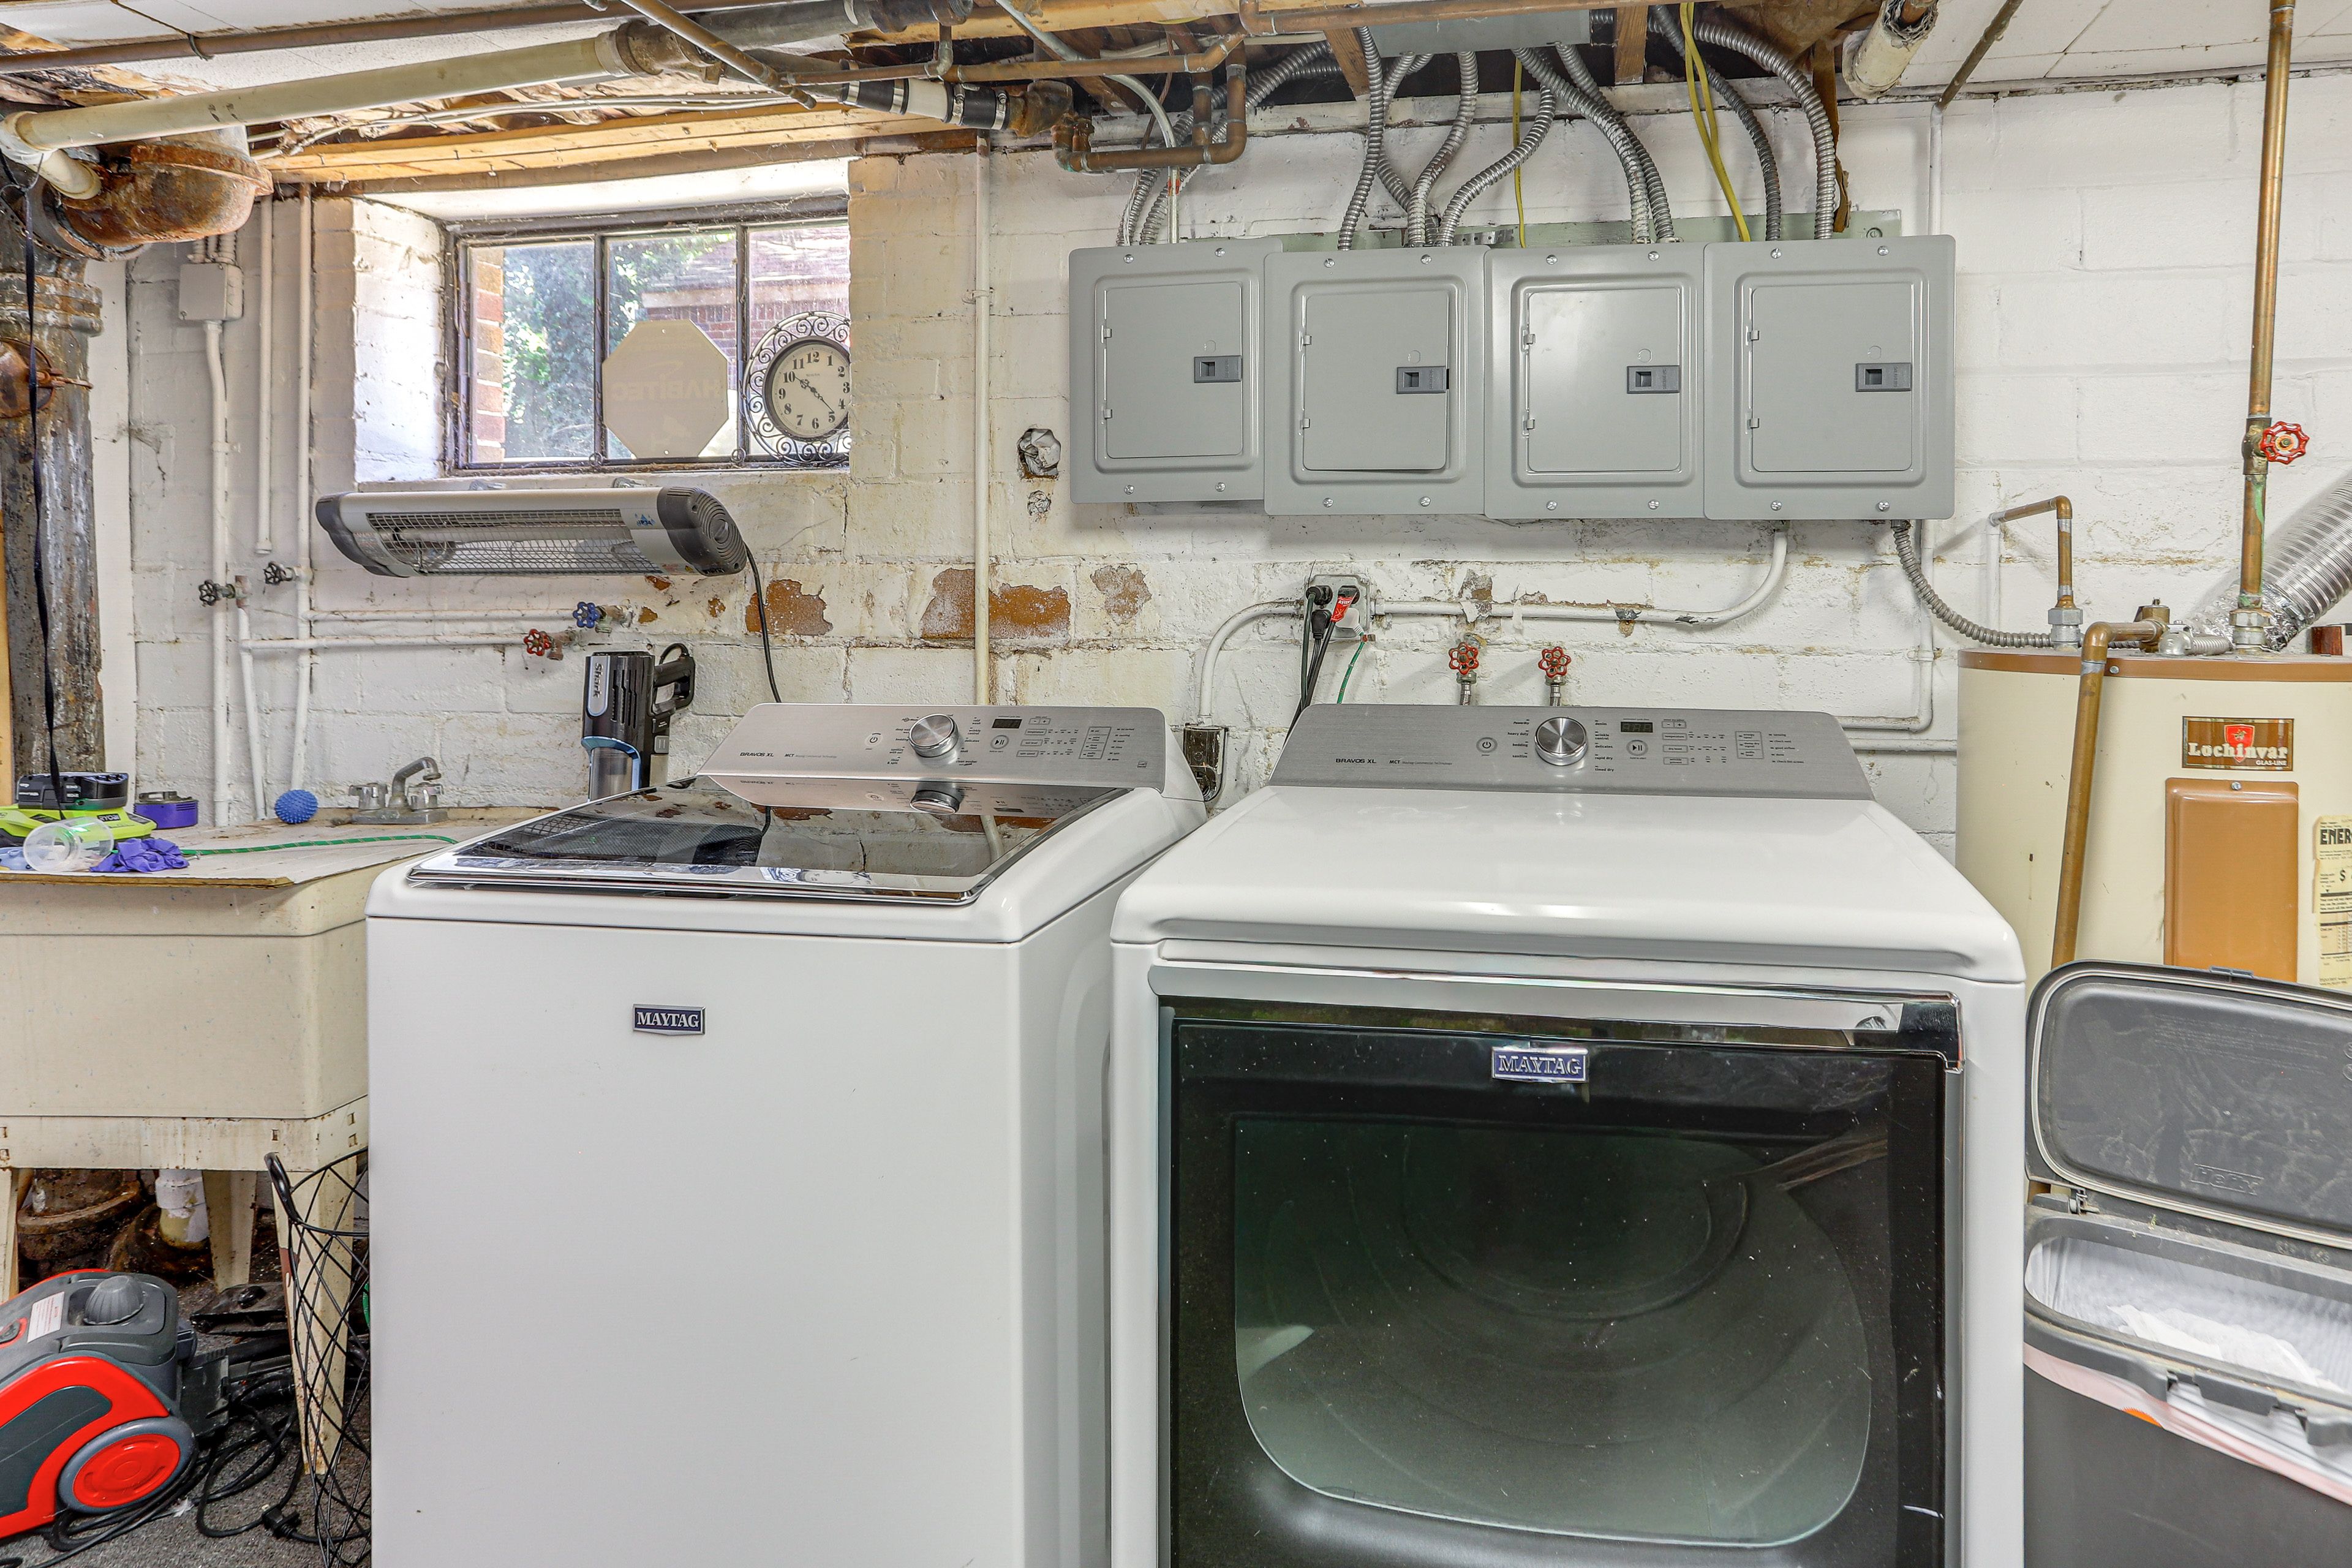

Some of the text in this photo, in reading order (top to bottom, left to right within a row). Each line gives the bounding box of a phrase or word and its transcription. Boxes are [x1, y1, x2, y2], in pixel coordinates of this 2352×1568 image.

[807, 351, 820, 363] 12
[827, 355, 833, 366] 1
[793, 358, 805, 370] 11
[783, 371, 795, 383] 10
[837, 366, 845, 378] 2
[778, 388, 786, 399] 9
[843, 382, 850, 393] 3
[784, 402, 792, 415] 8
[838, 398, 846, 410] 4
[797, 414, 804, 426] 7
[828, 410, 835, 423] 5
[812, 417, 819, 429] 6
[593, 663, 603, 698] Shark
[2188, 742, 2288, 760] Lochinvar
[2320, 828, 2352, 845] ENER
[637, 1011, 699, 1028] MAYTAG
[1498, 1055, 1582, 1075] MAYTAG
